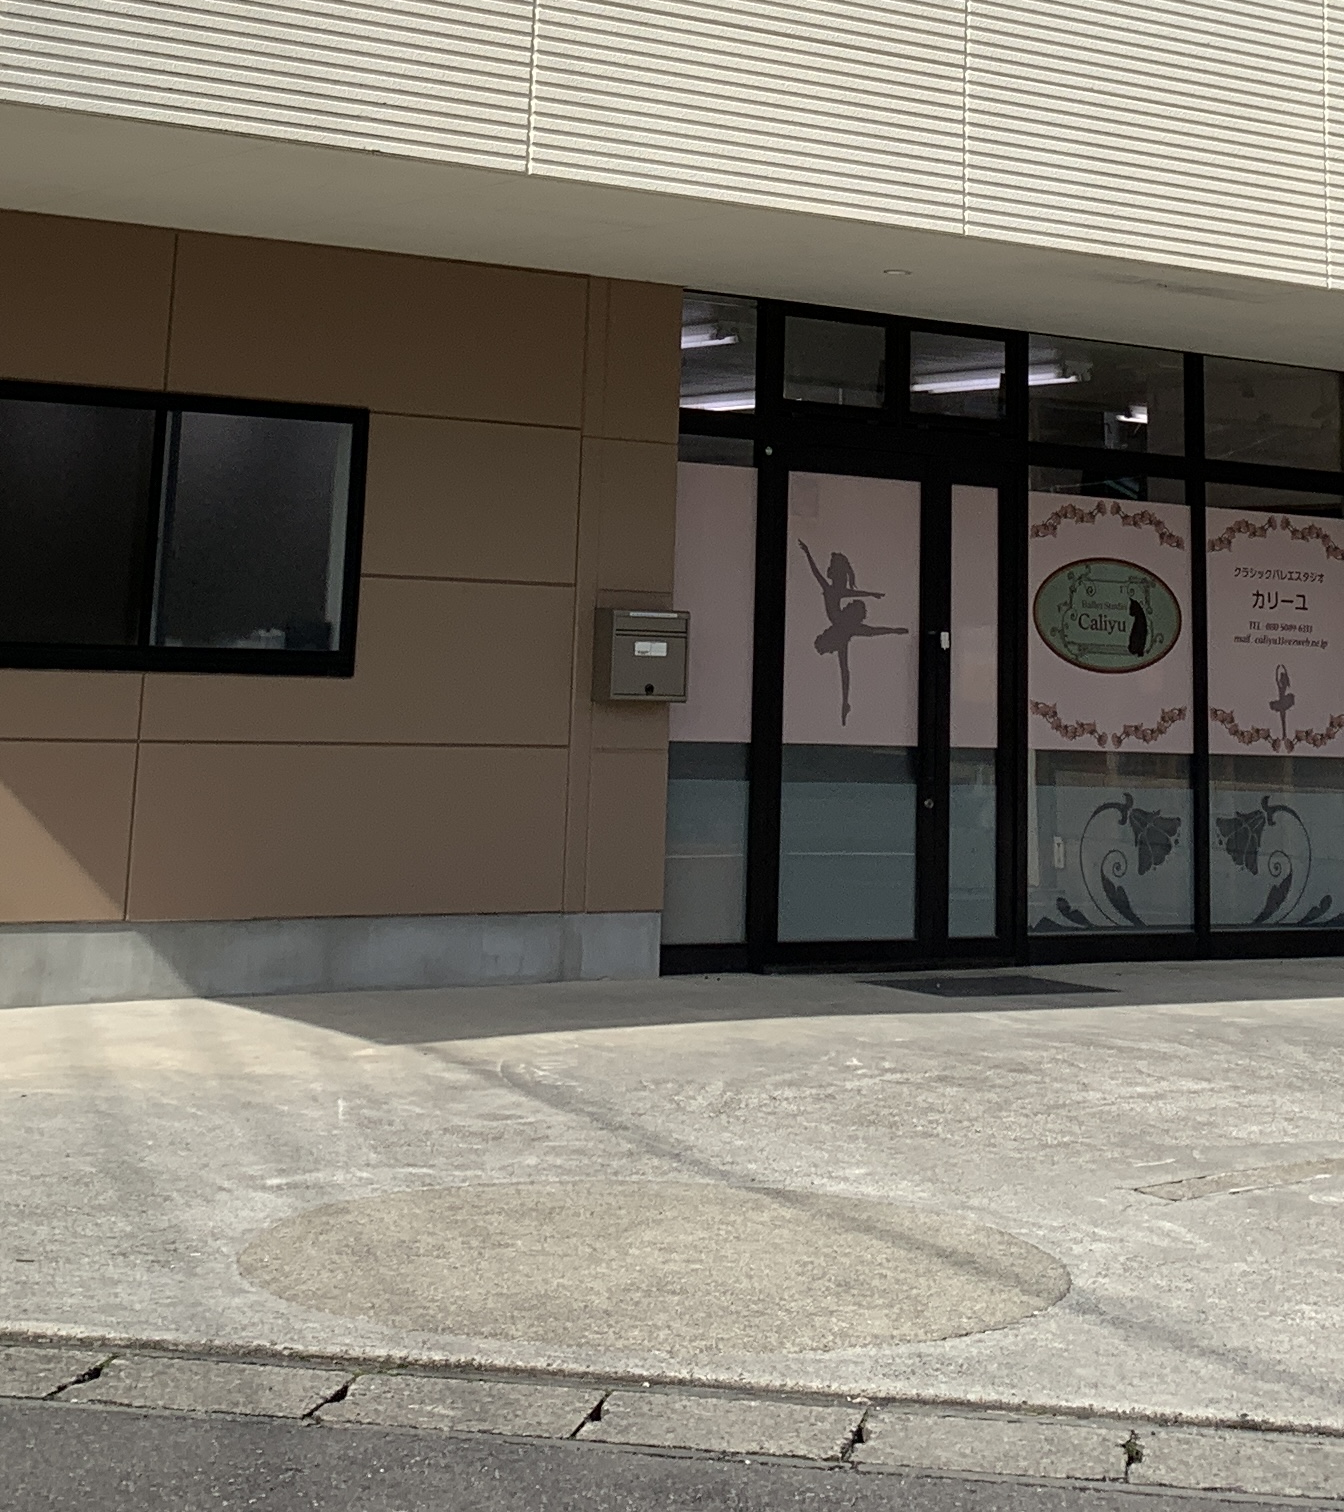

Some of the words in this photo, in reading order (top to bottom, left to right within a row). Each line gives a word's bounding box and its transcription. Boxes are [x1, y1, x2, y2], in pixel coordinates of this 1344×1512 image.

[1234, 567, 1325, 583] クラシックバレエスタジオ
[1252, 590, 1308, 610] カリーユ
[1078, 612, 1127, 635] Caliyu
